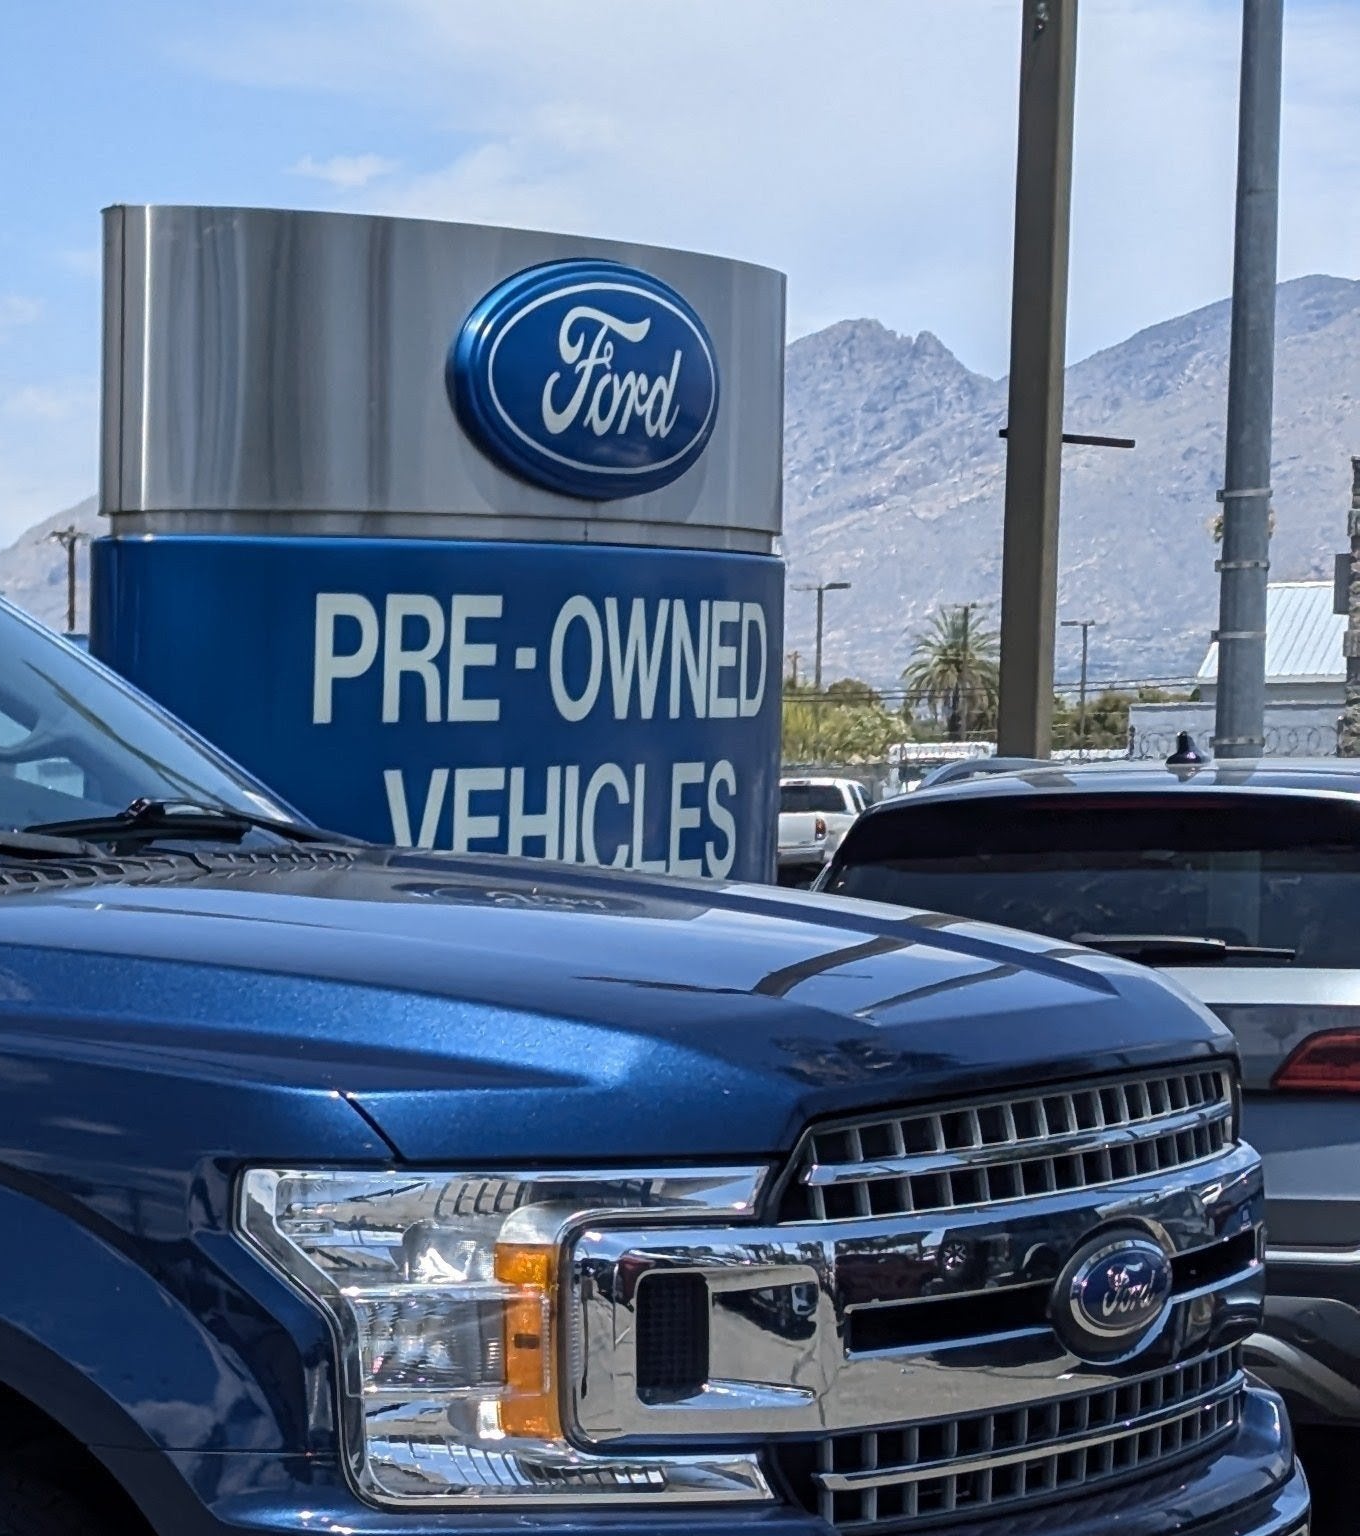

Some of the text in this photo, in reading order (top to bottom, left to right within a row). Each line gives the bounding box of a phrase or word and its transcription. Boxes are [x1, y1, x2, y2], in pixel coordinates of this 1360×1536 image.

[541, 305, 682, 438] Ford
[312, 592, 768, 725] PRE-OWNED
[383, 759, 738, 880] VEHICLES
[1102, 1262, 1156, 1317] Ford
